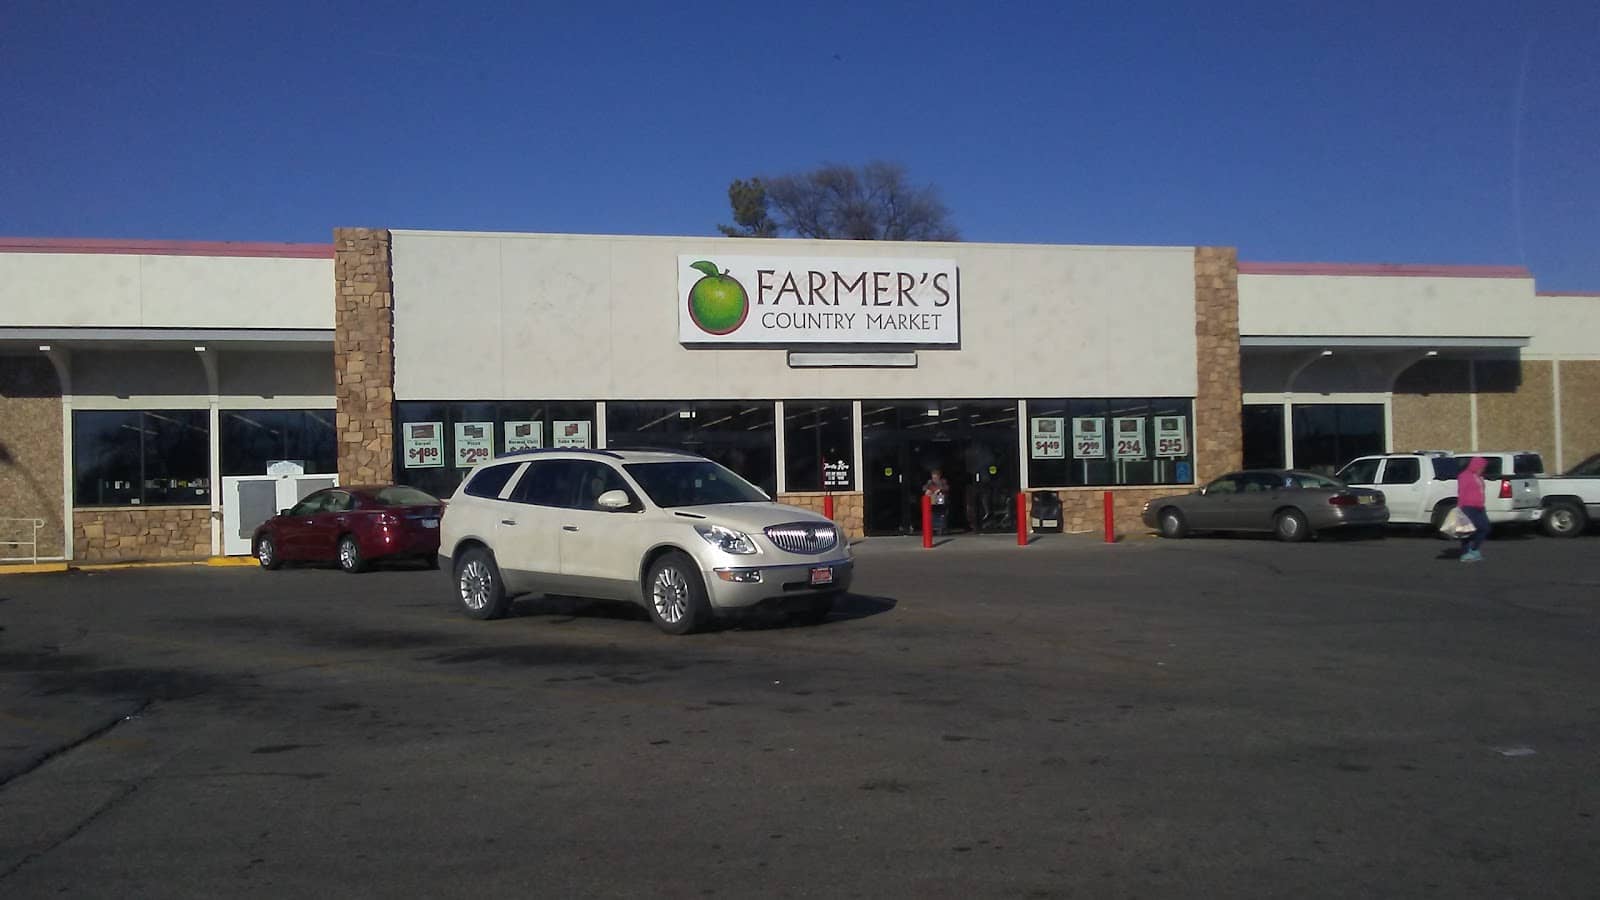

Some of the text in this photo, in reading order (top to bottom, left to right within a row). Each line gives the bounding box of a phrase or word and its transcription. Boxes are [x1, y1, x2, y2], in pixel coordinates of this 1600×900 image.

[756, 269, 950, 307] FARMER'S
[761, 312, 942, 330] COUNTRY MARKET
